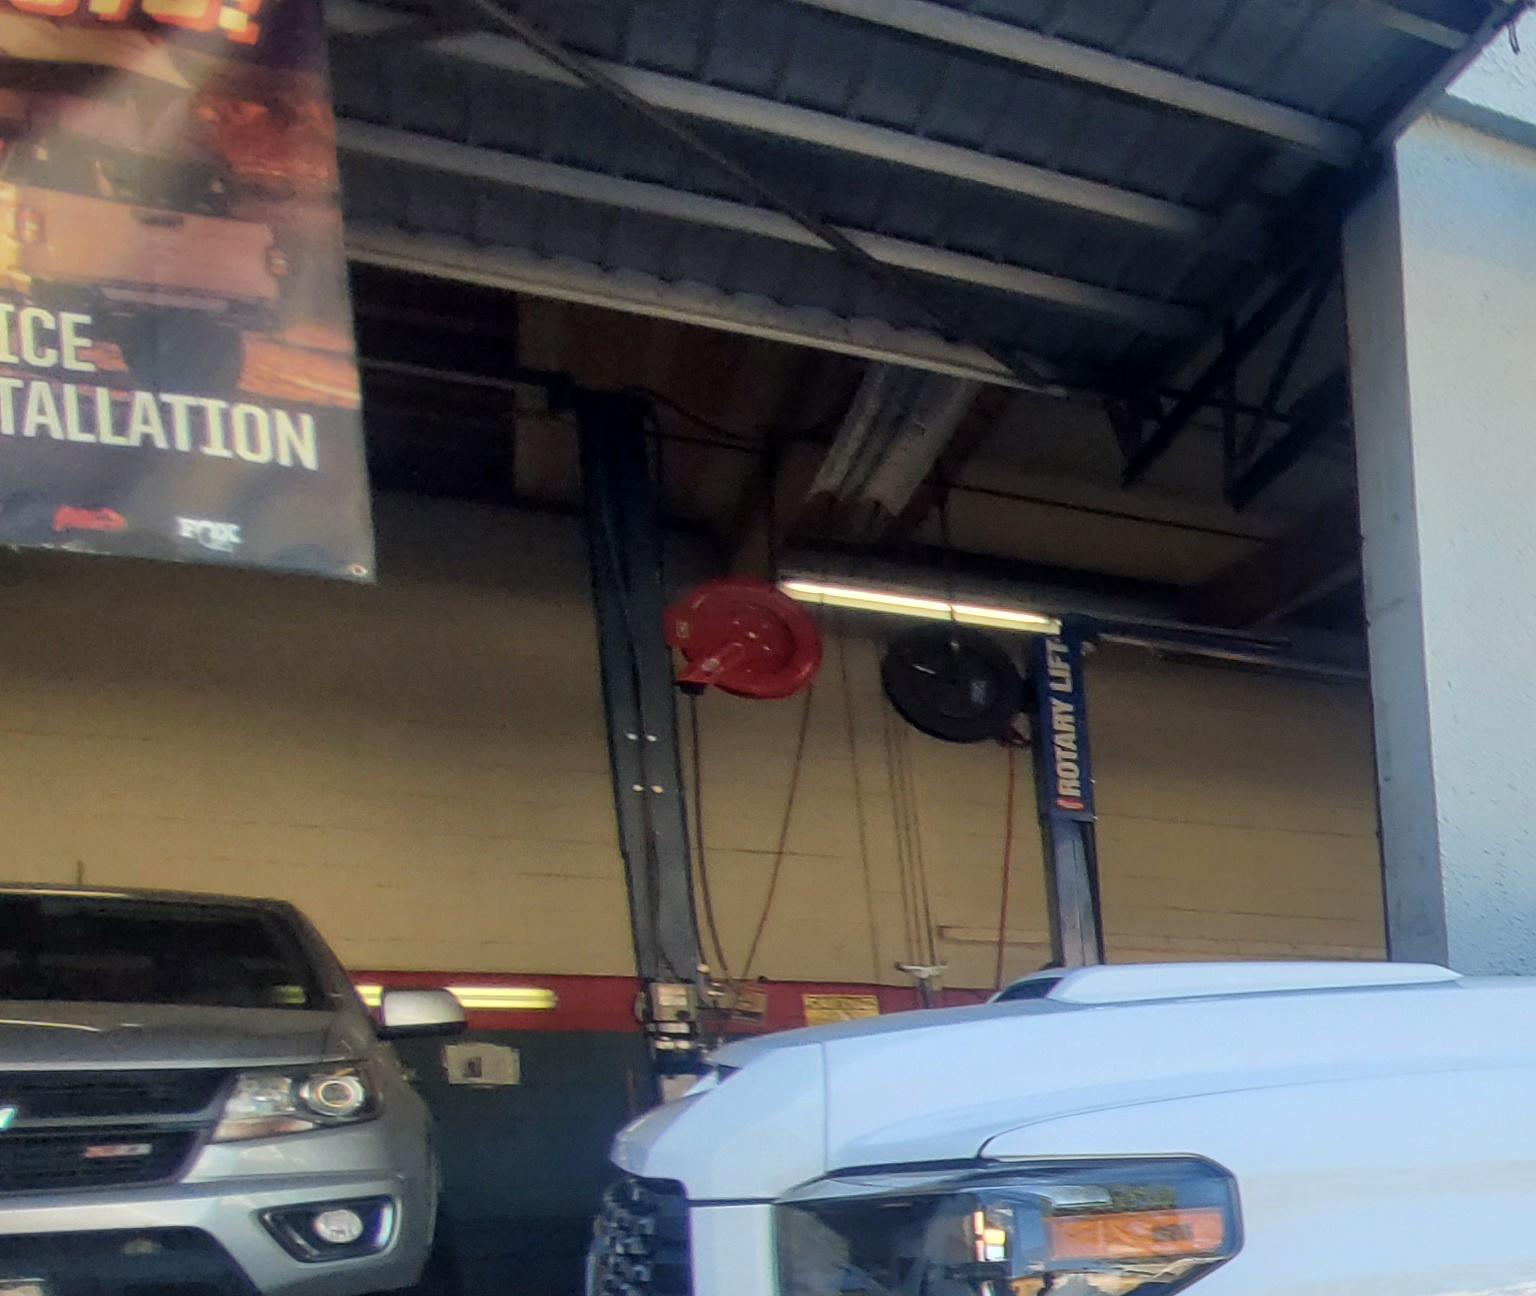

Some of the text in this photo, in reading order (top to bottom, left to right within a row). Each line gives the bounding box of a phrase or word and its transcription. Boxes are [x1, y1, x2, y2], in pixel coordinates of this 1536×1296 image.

[176, 516, 243, 548] FOX
[1046, 638, 1081, 797] ROTARY LIFT
